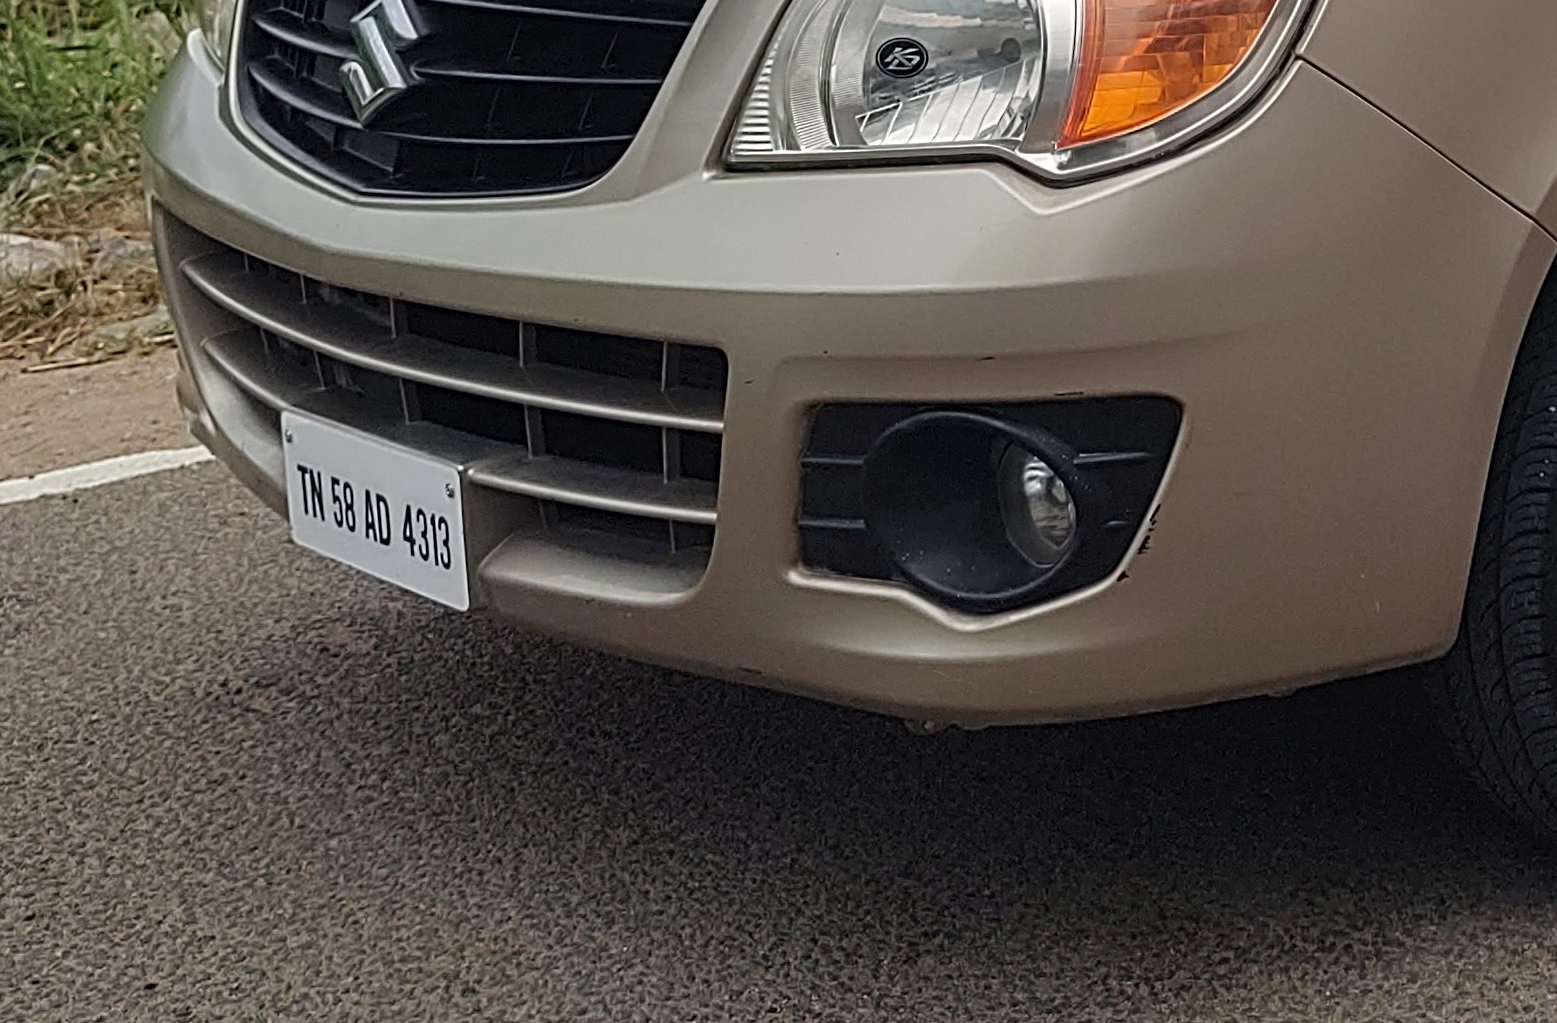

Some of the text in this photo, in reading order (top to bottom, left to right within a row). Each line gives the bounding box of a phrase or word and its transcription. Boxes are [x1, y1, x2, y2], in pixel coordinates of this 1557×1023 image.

[297, 463, 452, 571] TN 58 AD 4313
